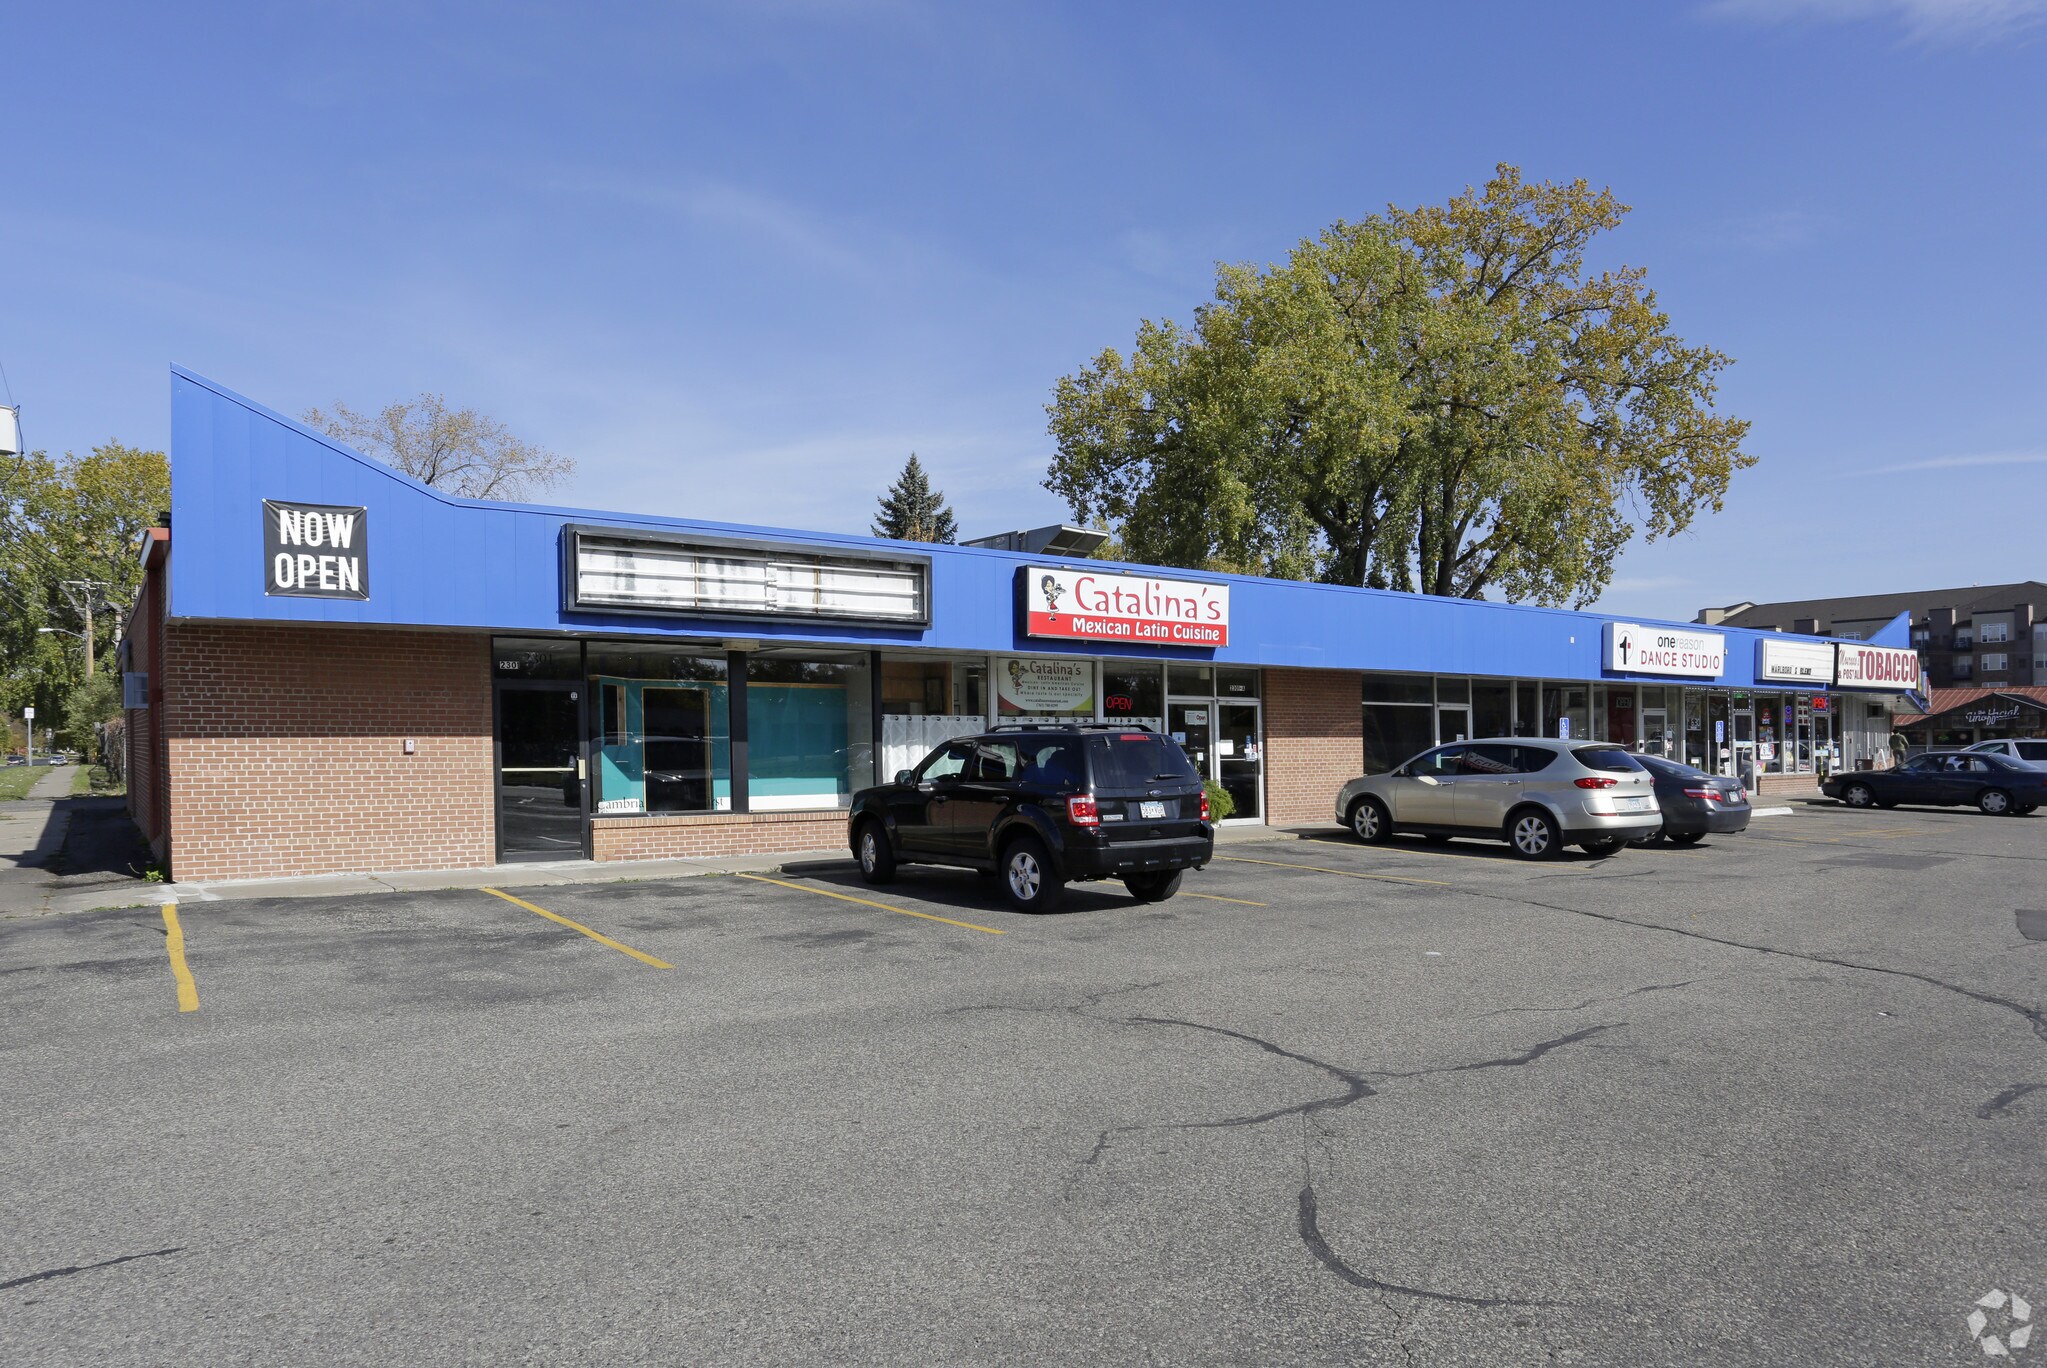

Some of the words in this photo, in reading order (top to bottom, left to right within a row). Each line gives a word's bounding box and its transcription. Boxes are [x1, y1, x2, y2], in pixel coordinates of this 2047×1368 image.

[279, 509, 354, 549] NOW
[274, 552, 359, 591] OPEN
[1074, 576, 1221, 621] Catalina's
[1072, 617, 1131, 636] Mexican
[1135, 621, 1169, 638] Latin
[1173, 624, 1220, 641] Cuisine
[1029, 660, 1082, 676] Catalina's
[1640, 650, 1677, 667] DANCE
[1681, 653, 1720, 670] STUDIO
[1858, 650, 1917, 683] TOBACCO
[1106, 696, 1133, 710] OPEN
